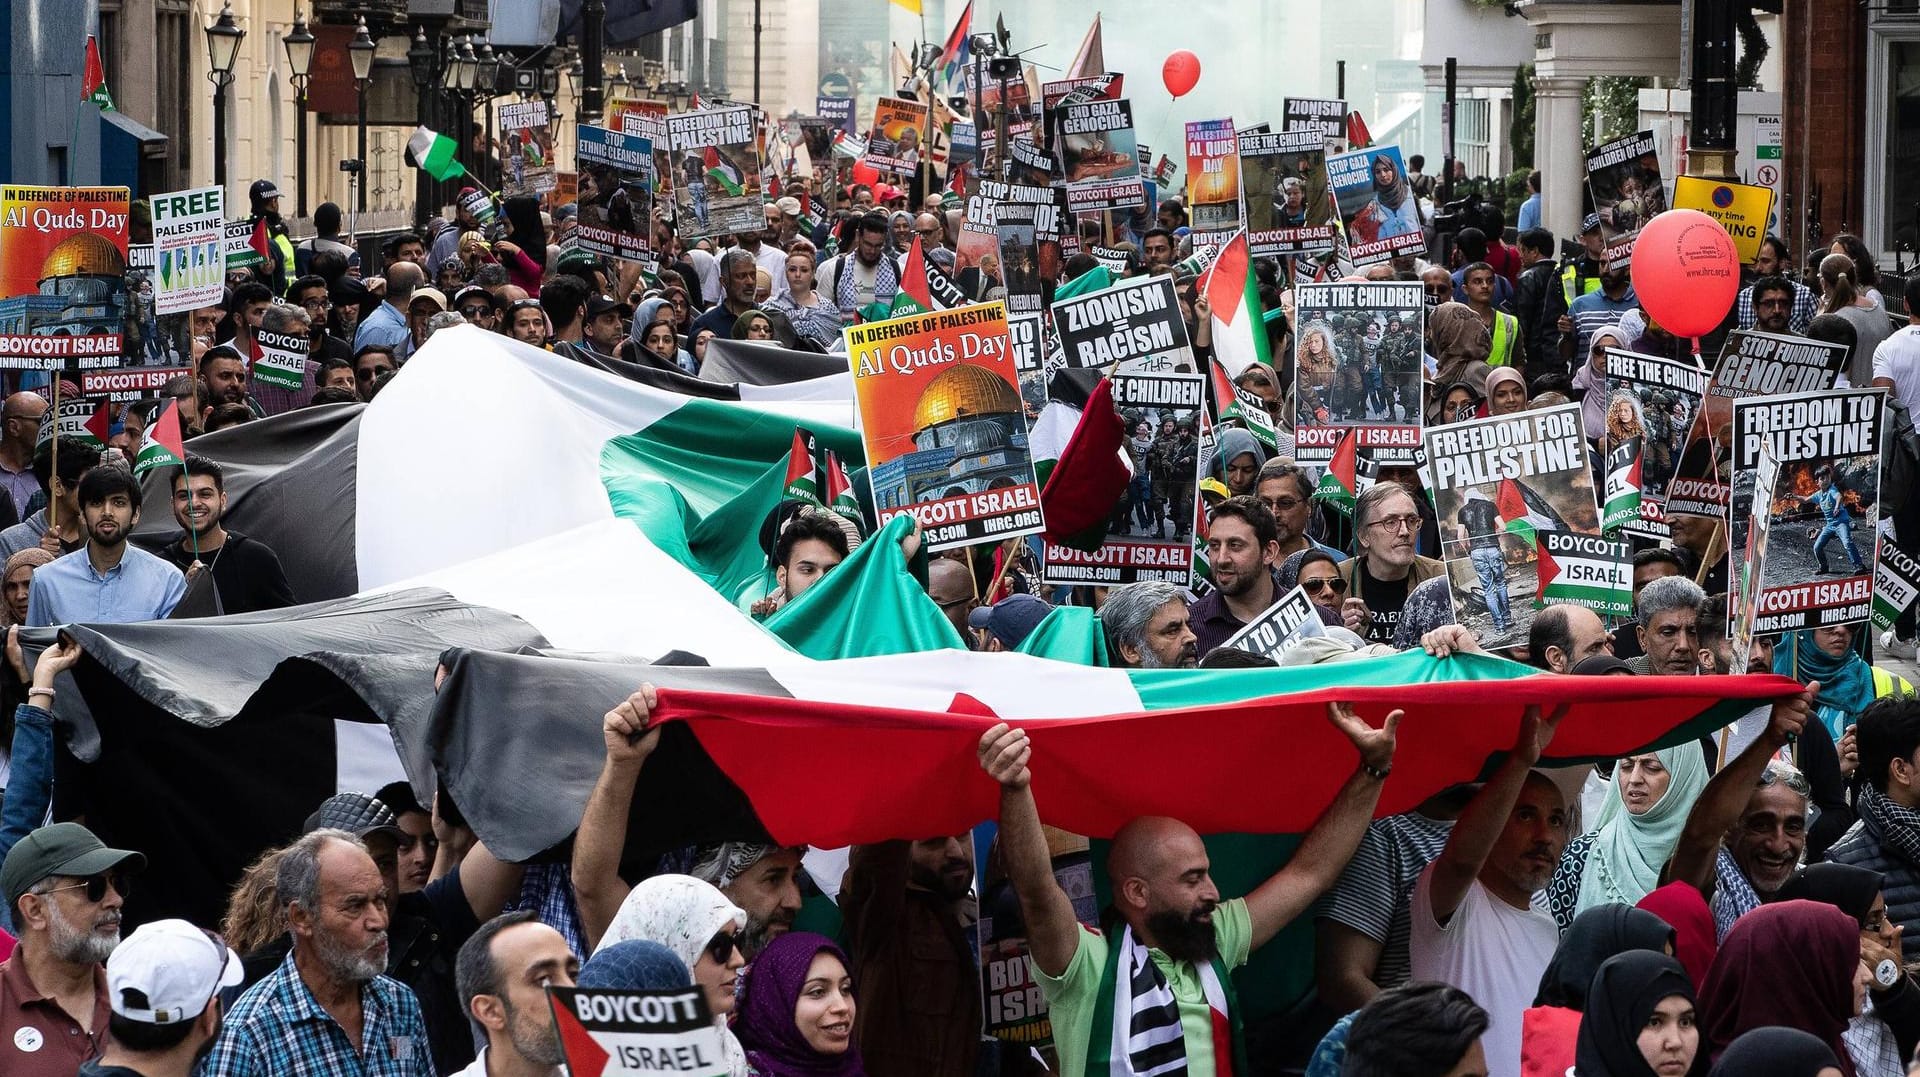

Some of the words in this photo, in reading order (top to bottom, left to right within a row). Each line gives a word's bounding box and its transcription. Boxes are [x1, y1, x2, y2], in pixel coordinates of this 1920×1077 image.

[500, 103, 533, 116] FREEDOM
[534, 100, 546, 112] FOR
[820, 100, 850, 108] Israeli
[820, 110, 848, 118] Peace
[1068, 106, 1090, 119] END
[1090, 102, 1120, 117] GAZA
[1288, 100, 1342, 116] ZIONISM
[501, 112, 548, 130] PALESTINE
[626, 118, 656, 133] FREEDOM
[669, 113, 724, 133] FREEDOM
[726, 110, 750, 126] FOR
[1064, 113, 1128, 134] GENOCIDE
[605, 132, 625, 148] STOP
[671, 124, 752, 151] PALESTINE
[1188, 129, 1234, 141] PALESTINE
[1240, 137, 1260, 150] FREE
[1261, 135, 1278, 148] THE
[1279, 132, 1323, 146] CHILDREN
[580, 140, 607, 156] ETHNIC
[608, 145, 651, 167] CLEANSING
[1189, 142, 1202, 156] AL
[1206, 140, 1234, 157] QUDS
[1588, 148, 1626, 172] CHILDREN
[1627, 145, 1635, 159] OF
[1636, 137, 1655, 154] GAZA
[1033, 156, 1052, 170] GAZA
[1203, 159, 1223, 172] DAY
[1329, 159, 1348, 175] STOP
[1349, 155, 1370, 170] GAZA
[1332, 169, 1370, 188] GENOCIDE
[5, 190, 15, 200] IN
[18, 190, 61, 202] DEFENCE
[64, 191, 76, 202] OF
[80, 190, 127, 202] PALESTINE
[980, 180, 1008, 199] STOP
[1010, 185, 1055, 203] FUNDING
[1069, 189, 1109, 201] BOYCOTT
[1110, 186, 1141, 197] ISRAEL
[154, 191, 220, 220] FREE
[1708, 210, 1722, 219] any
[1725, 211, 1745, 221] time
[4, 206, 27, 227] Al
[33, 208, 85, 233] Quds
[91, 208, 127, 234] Day
[156, 218, 221, 237] PALESTINE
[225, 224, 254, 237] COTT
[578, 225, 616, 244] BOYCOTT
[618, 234, 648, 250] ISRAEL
[1250, 230, 1295, 244] BOYCOTT
[1296, 227, 1331, 239] ISRAEL
[1350, 240, 1391, 257] BOYCOTT
[1392, 233, 1422, 247] ISRAEL
[1092, 246, 1128, 258] BOYCOTT
[924, 260, 964, 303] YCOTT
[1300, 287, 1329, 307] FREE
[1331, 286, 1355, 306] THE
[1357, 287, 1421, 308] CHILDREN
[1064, 284, 1167, 332] ZIONISM
[851, 331, 864, 345] IN
[868, 322, 920, 342] DEFENCE
[923, 317, 937, 332] OF
[940, 307, 1003, 330] PALESTINE
[1009, 321, 1033, 344] TO
[0, 338, 69, 354] BOYCOTT
[73, 337, 120, 353] ISRAEL
[1077, 320, 1175, 368] RACISM
[1739, 336, 1776, 359] STOP
[1774, 342, 1831, 367] FUNDING
[78, 356, 119, 368] IHRC.ORG
[268, 352, 304, 370] ISRAEL
[857, 348, 885, 378] Al
[890, 338, 954, 375] Quds
[959, 333, 1008, 361] Day
[1607, 354, 1635, 379] FREE
[1638, 360, 1662, 384] THE
[1718, 354, 1834, 394] GENOCIDE
[85, 375, 144, 389] BOYCOTT
[1126, 380, 1200, 405] CHILDREN
[1710, 386, 1720, 396] US
[1721, 388, 1734, 397] AID
[1236, 386, 1263, 407] COTT
[1744, 402, 1840, 434] FREEDOM
[1849, 396, 1876, 421] TO
[1367, 428, 1417, 444] ISRAEL
[1432, 419, 1531, 457] FREEDOM
[1534, 413, 1576, 439] FOR
[1435, 437, 1584, 490] PALESTINE
[1673, 480, 1730, 499] BOYCOT
[882, 499, 967, 526] BYCOTT
[972, 487, 1036, 515] ISRAEL
[1667, 499, 1727, 517] INMINDS.COM
[983, 511, 1040, 533] IHRC.ORG
[1130, 547, 1188, 566] ISRAEL
[1549, 535, 1629, 558] BOYCOTT
[1048, 565, 1121, 581] INMINDS.COM
[1136, 568, 1186, 583] IHRC.ORG
[1567, 564, 1627, 585] ISRAEL
[1813, 580, 1870, 604] ISRAEL
[1876, 572, 1907, 605] RAEL
[1250, 621, 1276, 652] TO
[1273, 597, 1309, 632] THE
[1821, 604, 1869, 624] IHRC.ORG
[574, 993, 698, 1023] BOYCOTT
[991, 987, 1046, 1023] ISR
[617, 1044, 712, 1070] ISRAEL
